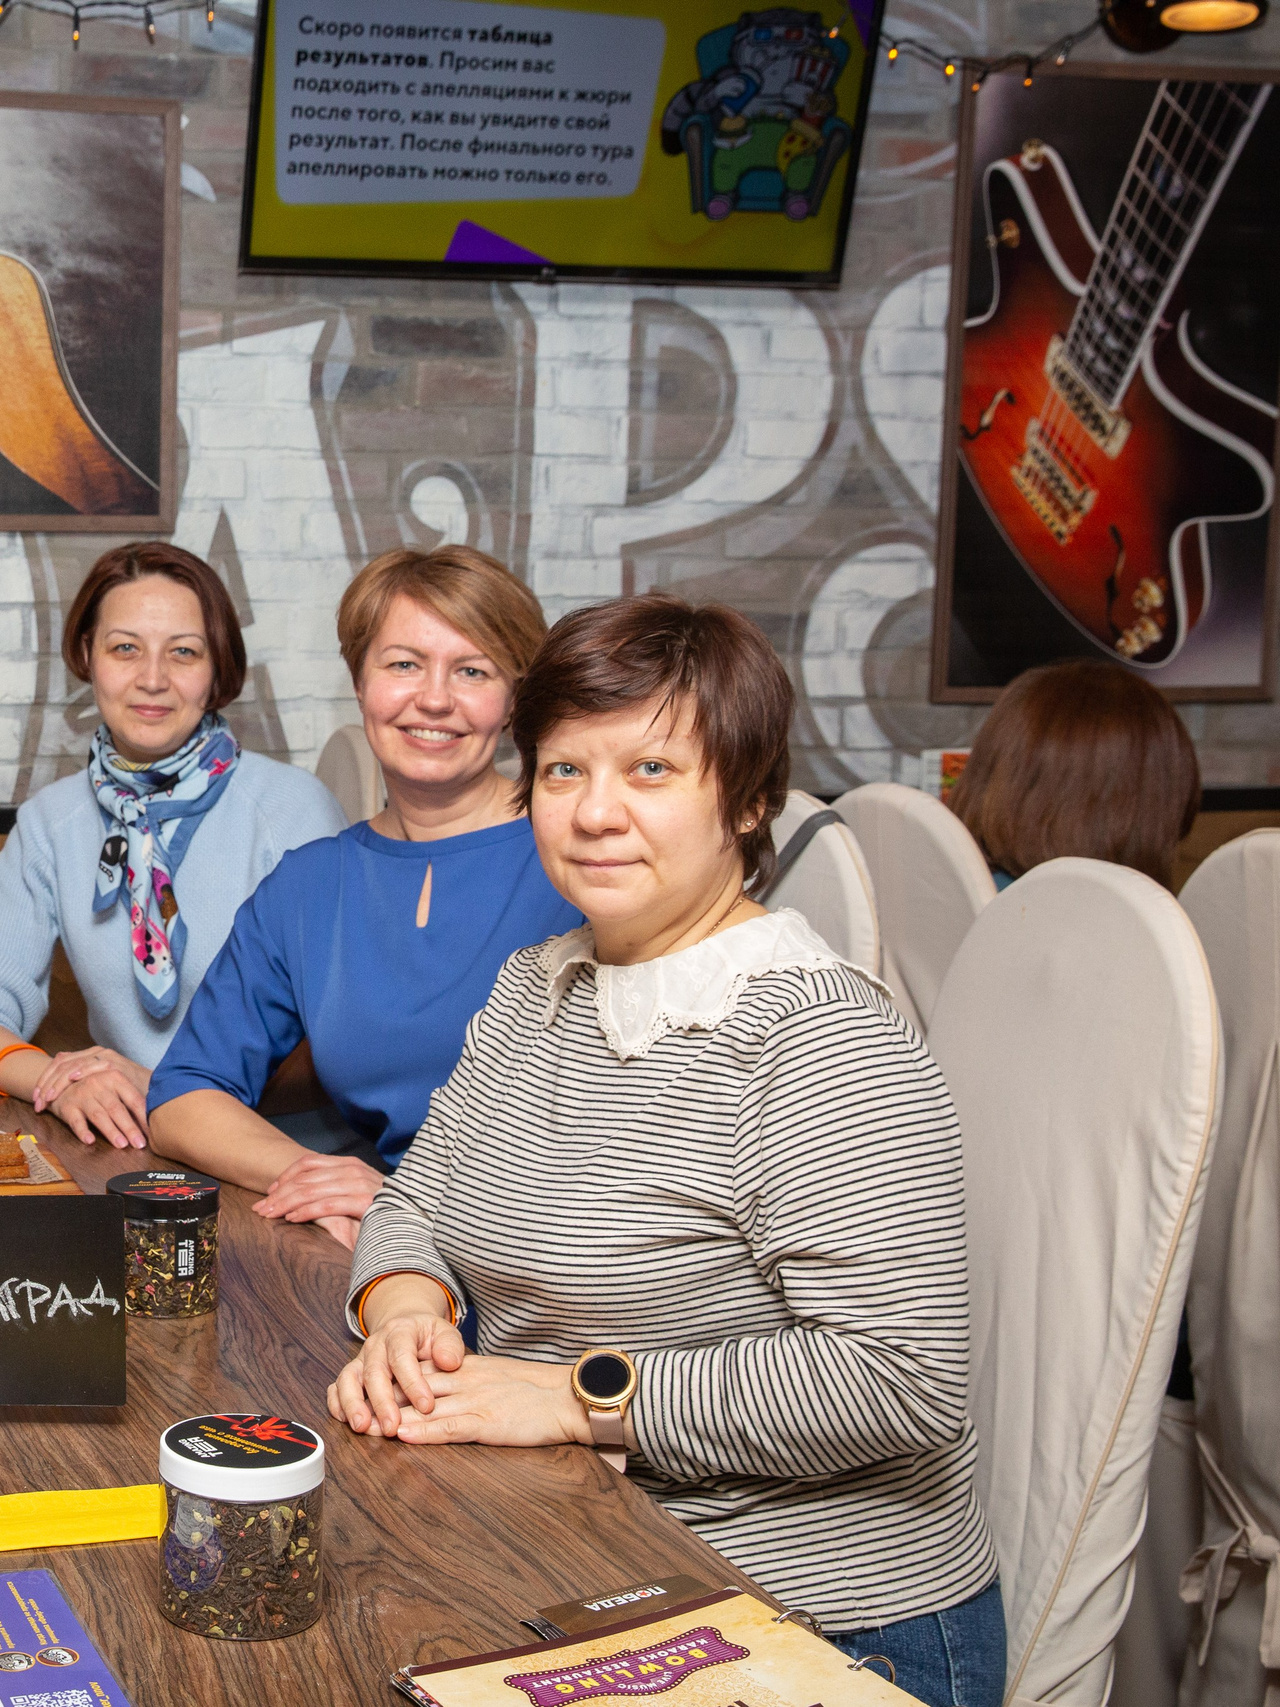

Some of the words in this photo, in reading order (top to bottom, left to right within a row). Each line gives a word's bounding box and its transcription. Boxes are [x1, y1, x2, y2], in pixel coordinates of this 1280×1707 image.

[297, 16, 365, 39] Скоро
[369, 24, 463, 41] появится
[467, 26, 553, 47] таблица
[295, 50, 433, 71] результатов.
[439, 52, 517, 74] Просим
[523, 58, 554, 73] вас
[293, 77, 401, 97] подходить
[405, 83, 417, 95] с
[420, 84, 555, 102] апелляциями
[558, 87, 570, 100] к
[573, 89, 632, 106] жюри
[291, 106, 353, 120] после
[357, 108, 405, 125] того,
[411, 111, 444, 124] как
[449, 112, 476, 125] вы
[480, 113, 560, 131] увидите
[564, 112, 610, 130] свой
[287, 133, 395, 153] результат.
[399, 134, 463, 155] После
[467, 138, 586, 161] финального
[591, 144, 635, 161] тура
[286, 162, 429, 181] апеллировать
[432, 168, 500, 181] можно
[503, 169, 572, 184] только
[574, 171, 612, 186] его.
[178, 1239, 188, 1276] TEA
[178, 1439, 210, 1458] AMAZING
[187, 1436, 223, 1457] TEA
[583, 1586, 668, 1612] ПОБЕДА
[638, 1638, 708, 1662] KARAOKE
[532, 1660, 630, 1688] RESTAURANT
[555, 1648, 708, 1694] BOWLING
[659, 1671, 673, 1686] LIVE
[618, 1682, 658, 1690] MUSIC
